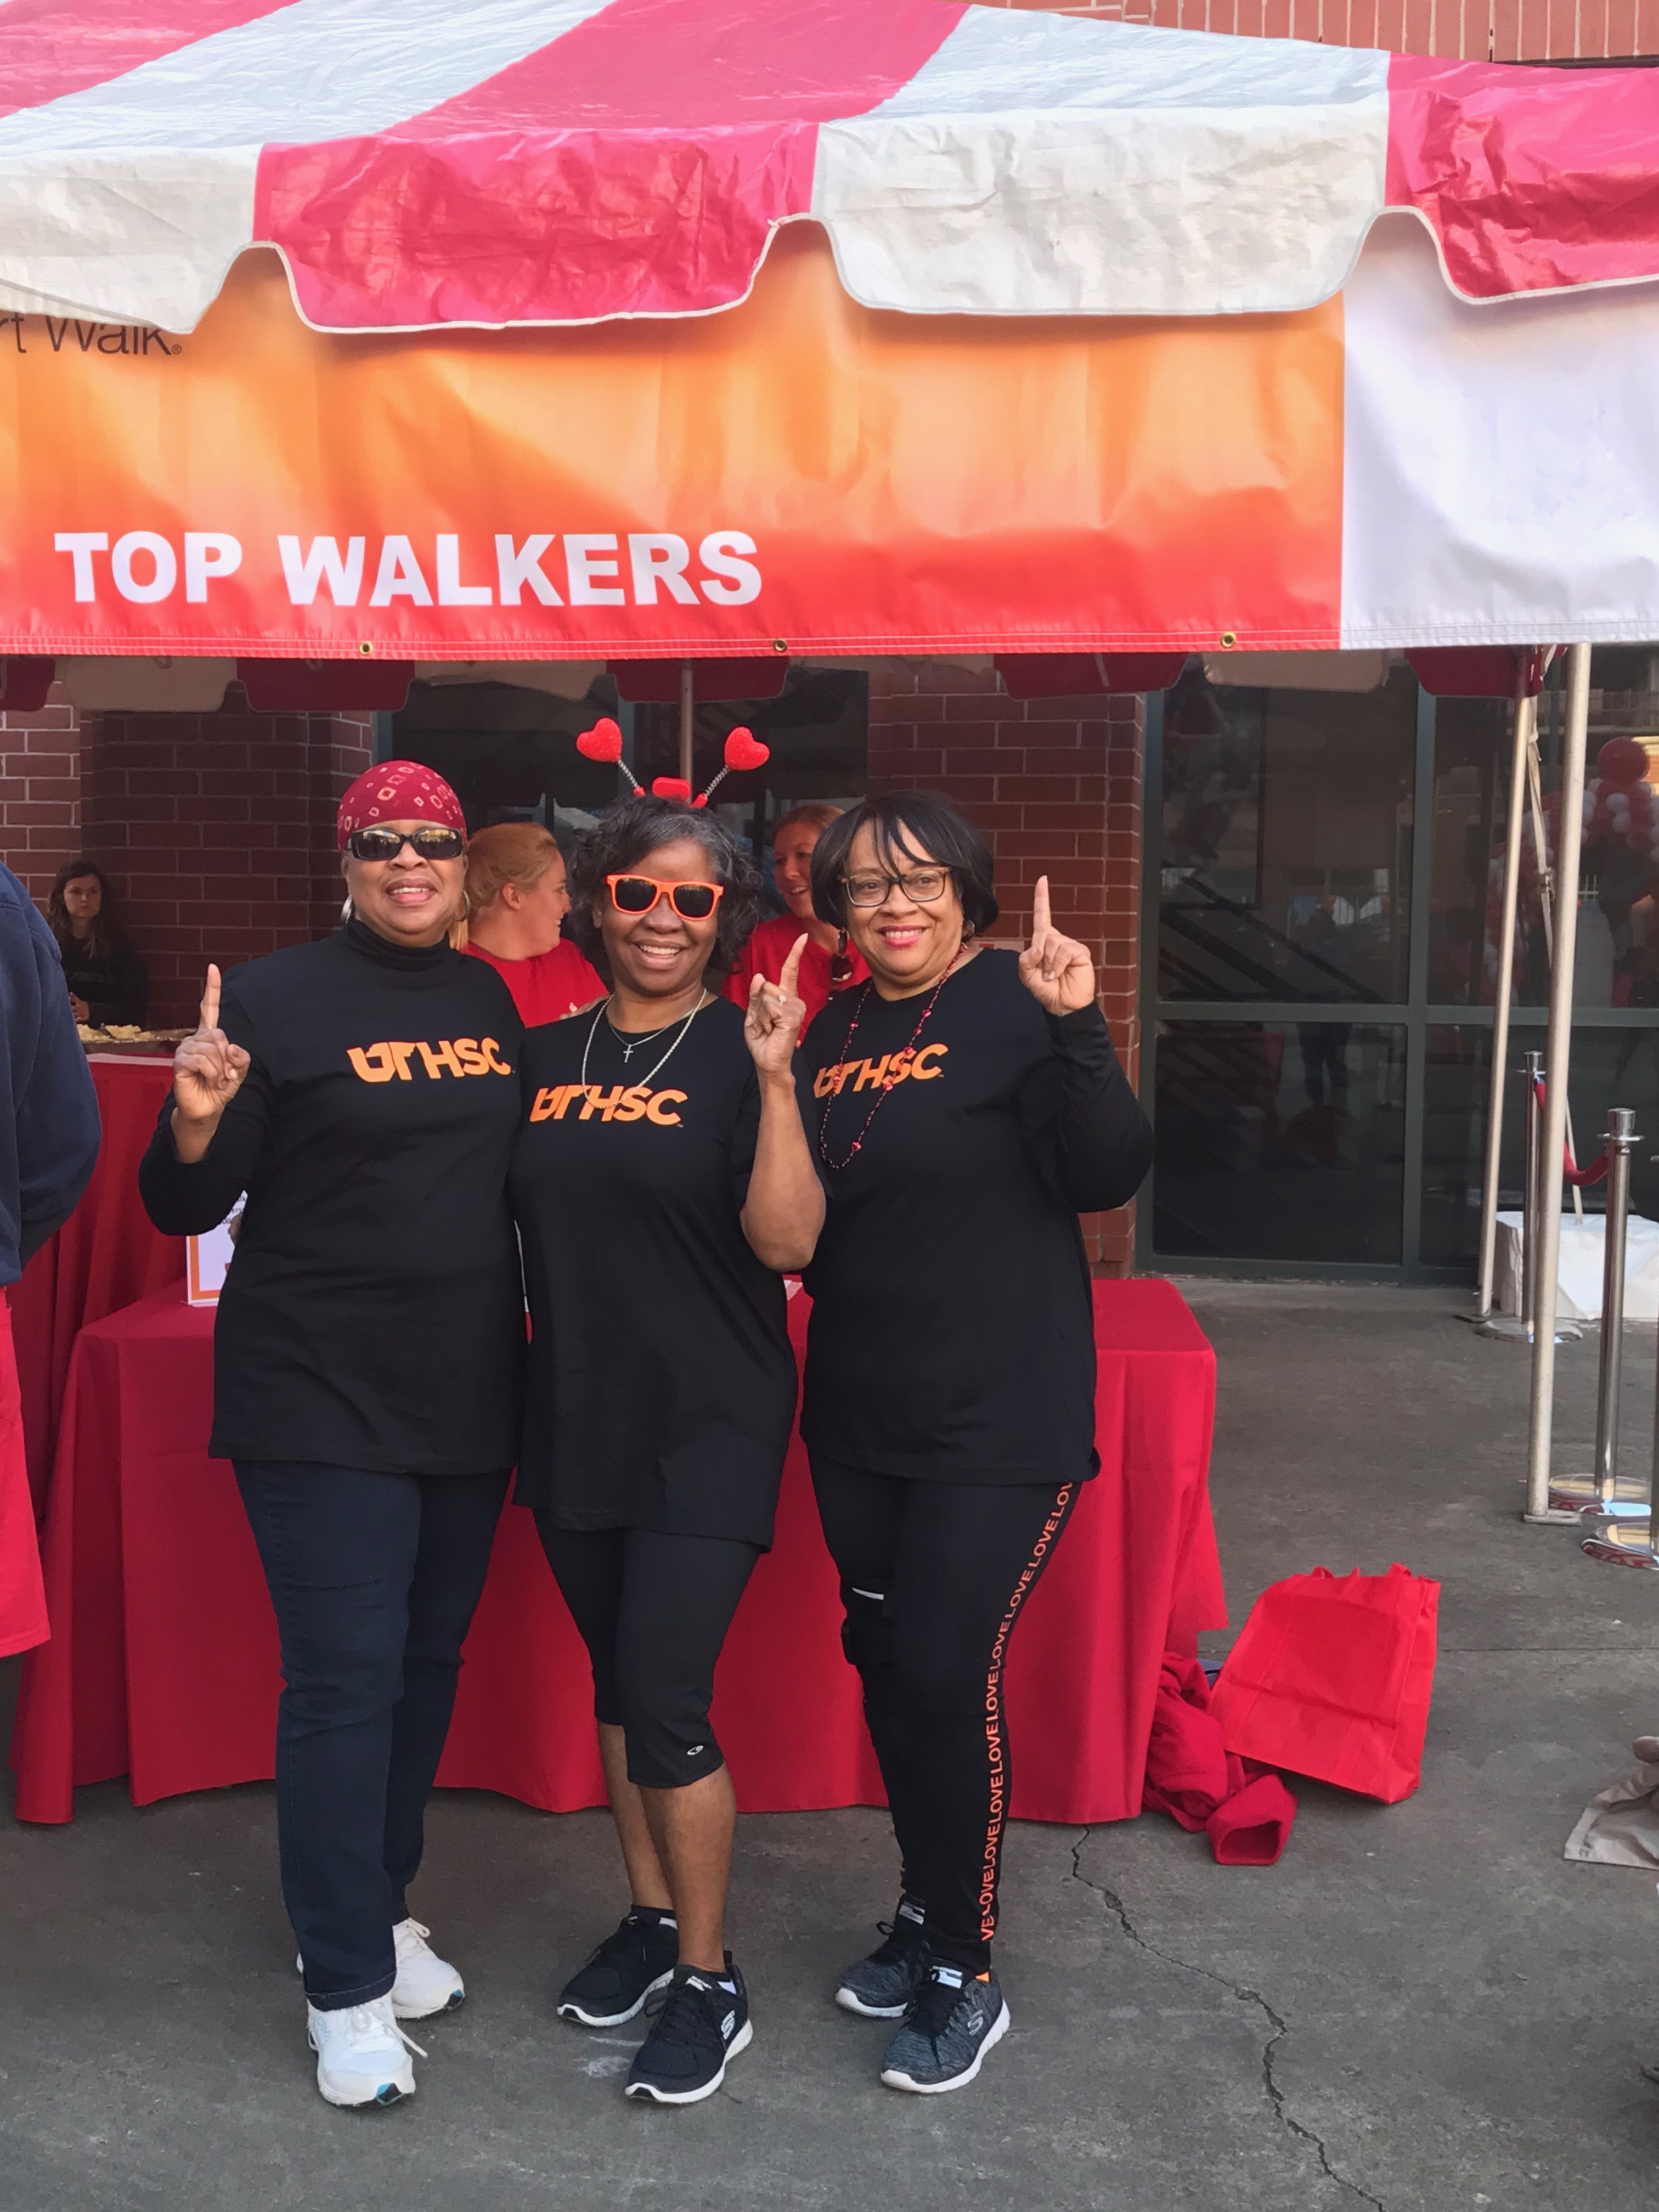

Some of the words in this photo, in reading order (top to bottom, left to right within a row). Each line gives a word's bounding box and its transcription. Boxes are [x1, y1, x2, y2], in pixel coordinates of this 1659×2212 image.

[55, 530, 242, 604] TOP
[277, 530, 763, 607] WALKERS
[346, 1037, 511, 1082] UTHSC
[813, 1043, 949, 1098] UTHSC
[529, 1085, 688, 1125] UTHSC
[1028, 1519, 1059, 1568] LOVE
[1004, 1570, 1035, 1618] LOVE
[990, 1621, 1011, 1671] LOVE
[986, 1671, 999, 1722] LOVE
[986, 1722, 1003, 1774] LOVE
[989, 1774, 1004, 1824] LOVE
[983, 1823, 1001, 1870] LOVE
[979, 1868, 995, 1916] LOVE
